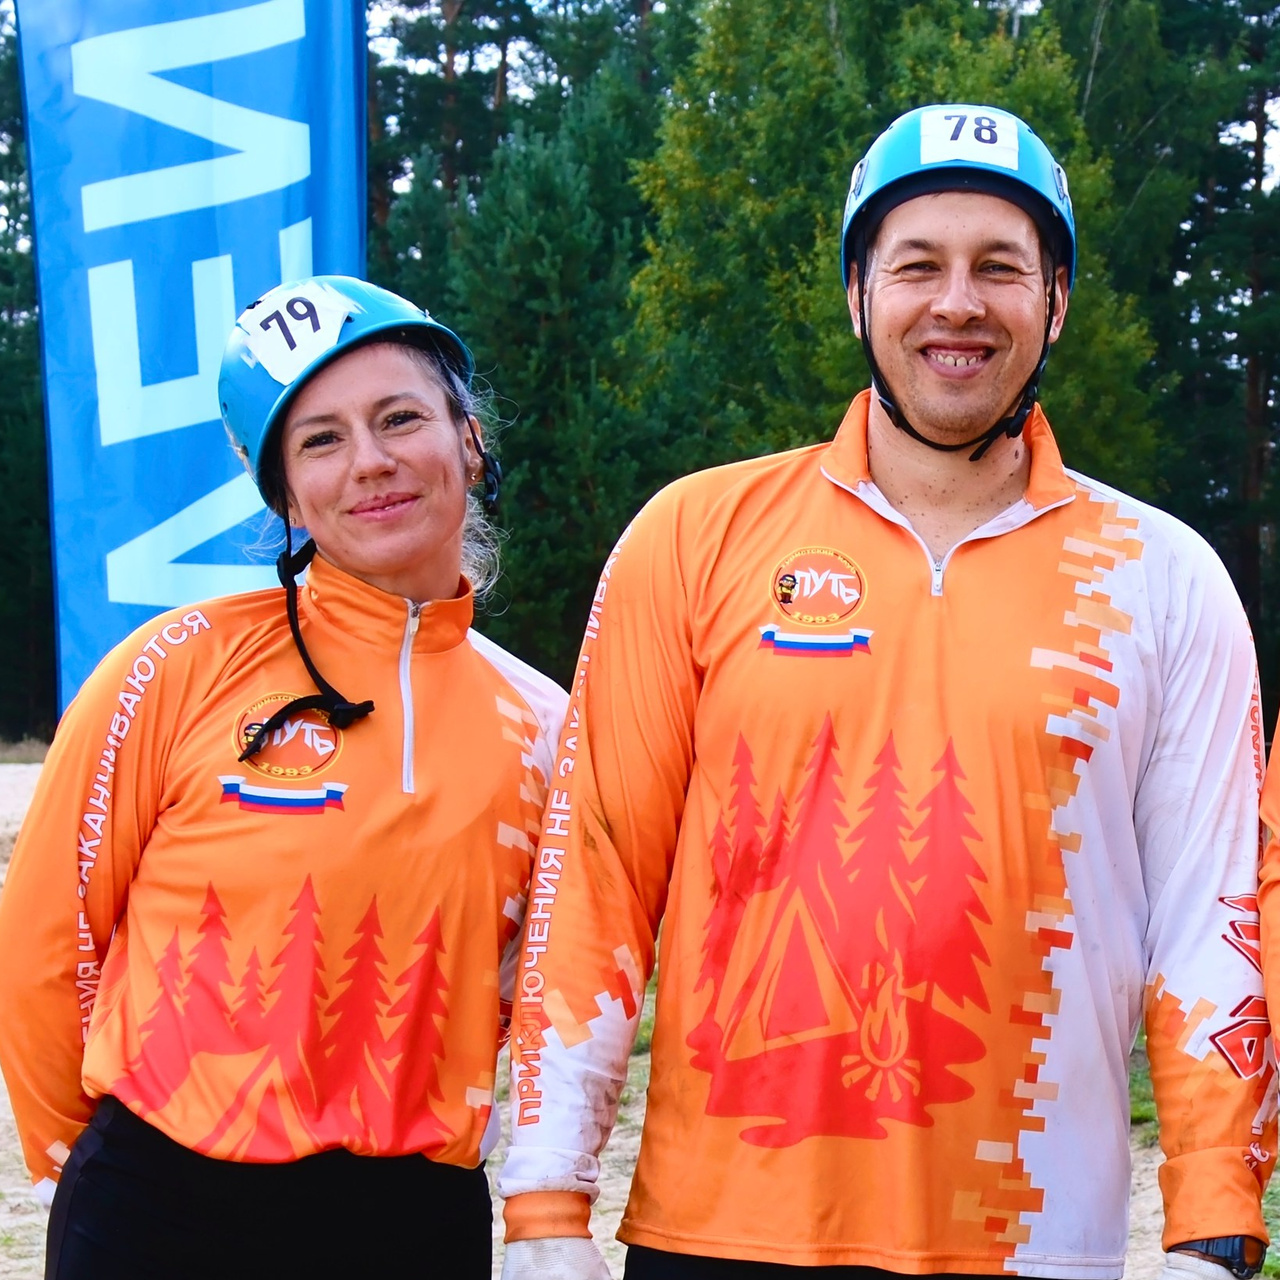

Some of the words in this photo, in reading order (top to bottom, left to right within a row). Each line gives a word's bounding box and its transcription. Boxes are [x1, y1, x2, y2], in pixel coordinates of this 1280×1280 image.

[944, 115, 998, 144] 78
[259, 297, 321, 351] 79
[793, 567, 860, 605] ПУТЬ
[791, 612, 841, 624] 1993
[259, 762, 314, 777] 1993
[516, 847, 567, 1127] ПРИКЛЮЧЕНИЯ
